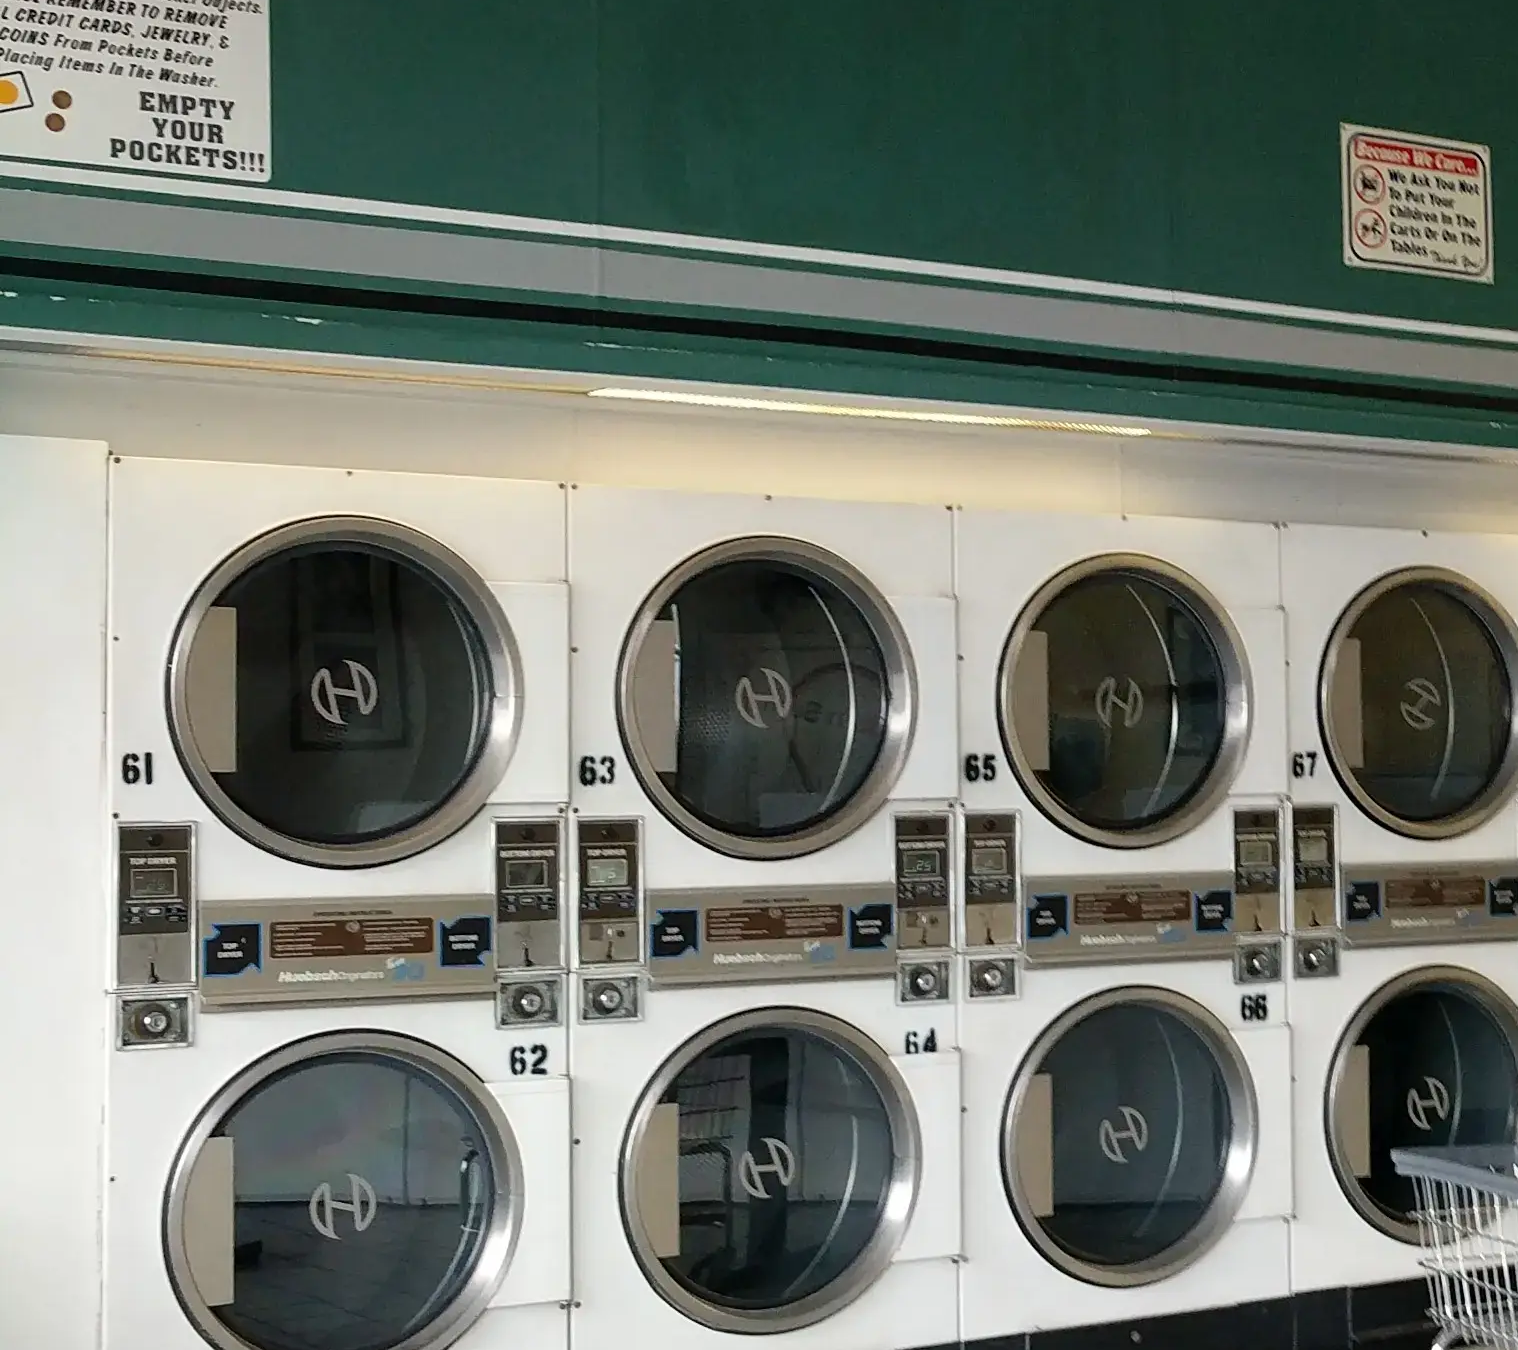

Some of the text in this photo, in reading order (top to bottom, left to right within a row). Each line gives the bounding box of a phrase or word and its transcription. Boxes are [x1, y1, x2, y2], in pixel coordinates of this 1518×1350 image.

[15, 8, 74, 29] CREDIT
[219, 35, 229, 50] &
[140, 3, 159, 19] TO
[163, 7, 229, 29] REMOVE
[0, 26, 214, 68] COINS From Pockets Before
[58, 56, 104, 74] Items
[109, 62, 124, 76] In
[128, 64, 154, 80] The
[139, 91, 235, 121] EMPTY
[152, 118, 224, 144] YOUR
[109, 138, 265, 173] POCKETS!!!
[1388, 169, 1406, 184] We
[1410, 174, 1431, 189] Ask
[1434, 176, 1456, 192] You
[1388, 186, 1402, 201] To
[1405, 189, 1425, 204] Put
[1389, 203, 1438, 223] Children
[1455, 214, 1477, 229] The
[1389, 222, 1421, 238] Carts
[1461, 231, 1481, 247] The
[122, 752, 154, 786] 61
[579, 755, 616, 787] 63
[965, 753, 997, 783] 65
[1292, 752, 1317, 779] 67
[1240, 994, 1268, 1022] 66
[904, 1027, 938, 1055] 64
[510, 1043, 548, 1076] 62
